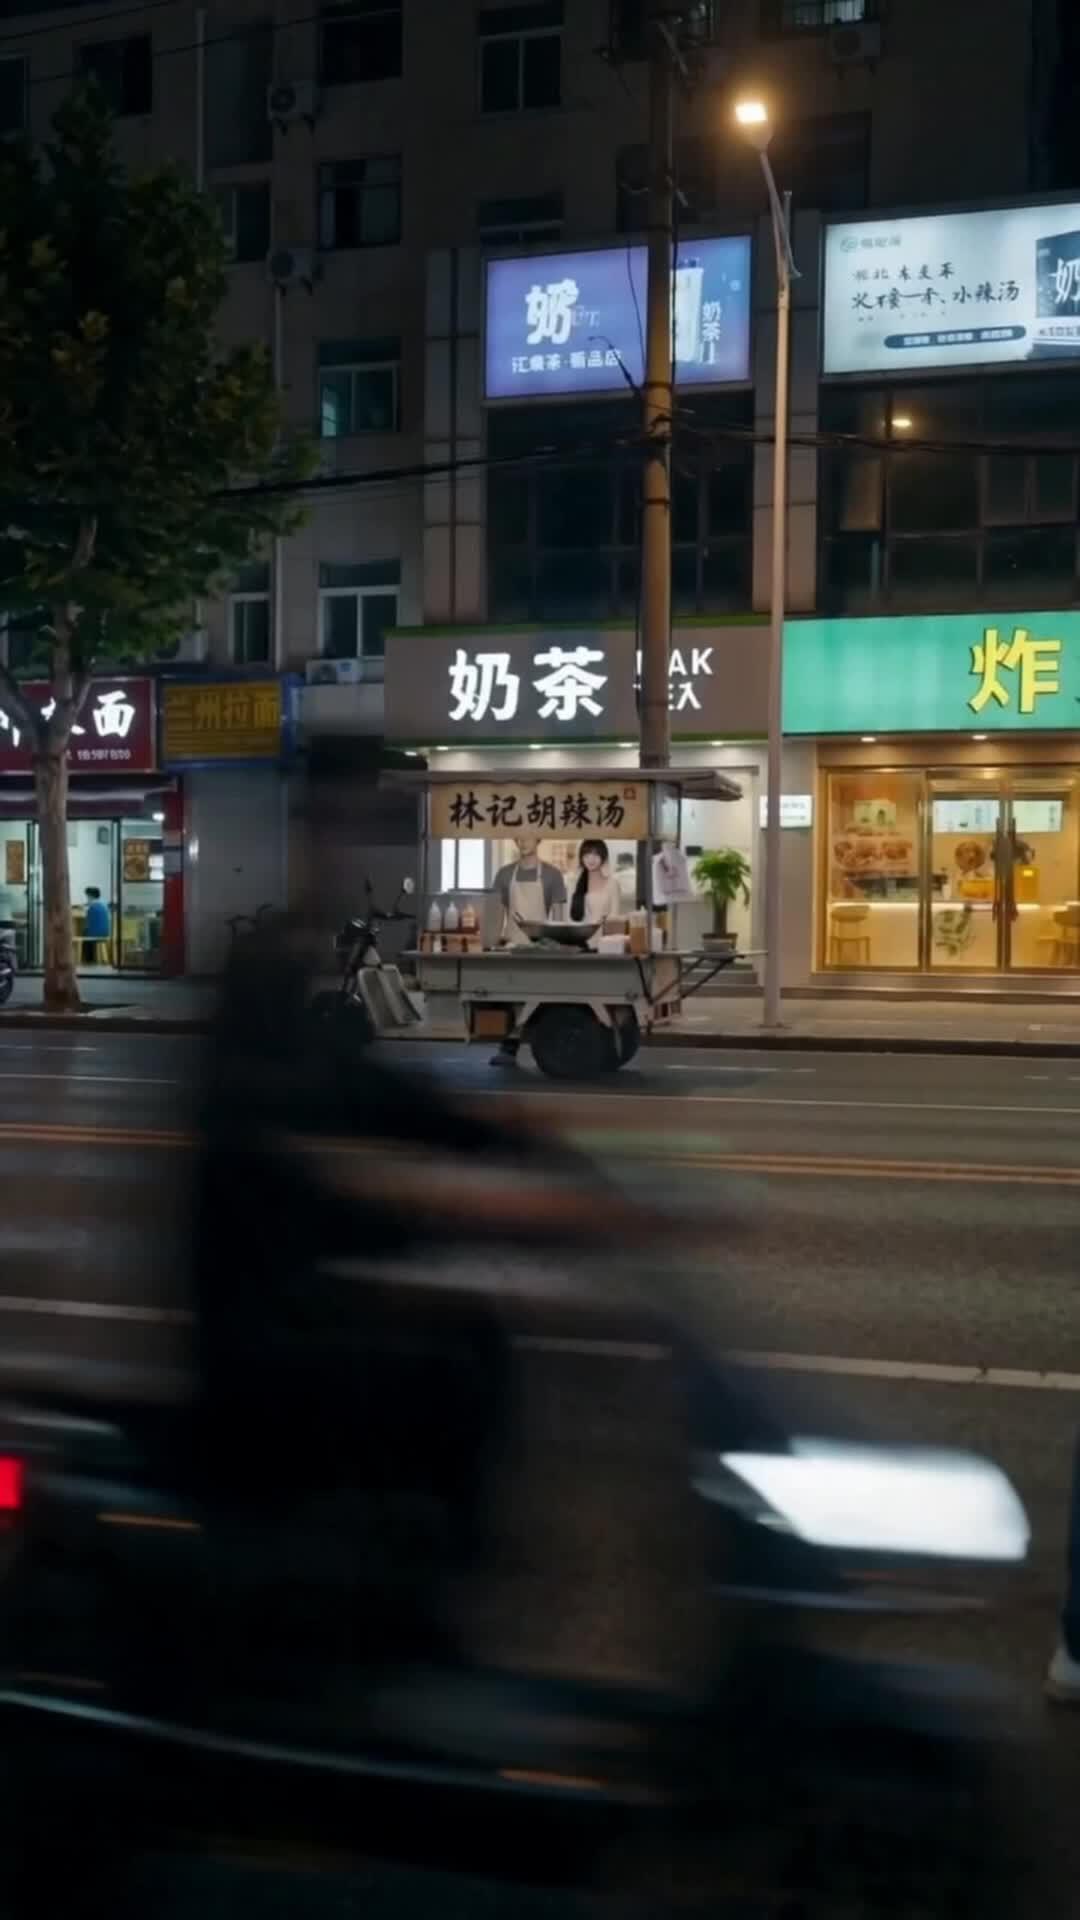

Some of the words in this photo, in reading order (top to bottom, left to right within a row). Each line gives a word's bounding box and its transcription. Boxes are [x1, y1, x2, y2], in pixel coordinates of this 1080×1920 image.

[448, 646, 608, 722] 奶茶
[449, 791, 626, 831] 林记胡辣汤
